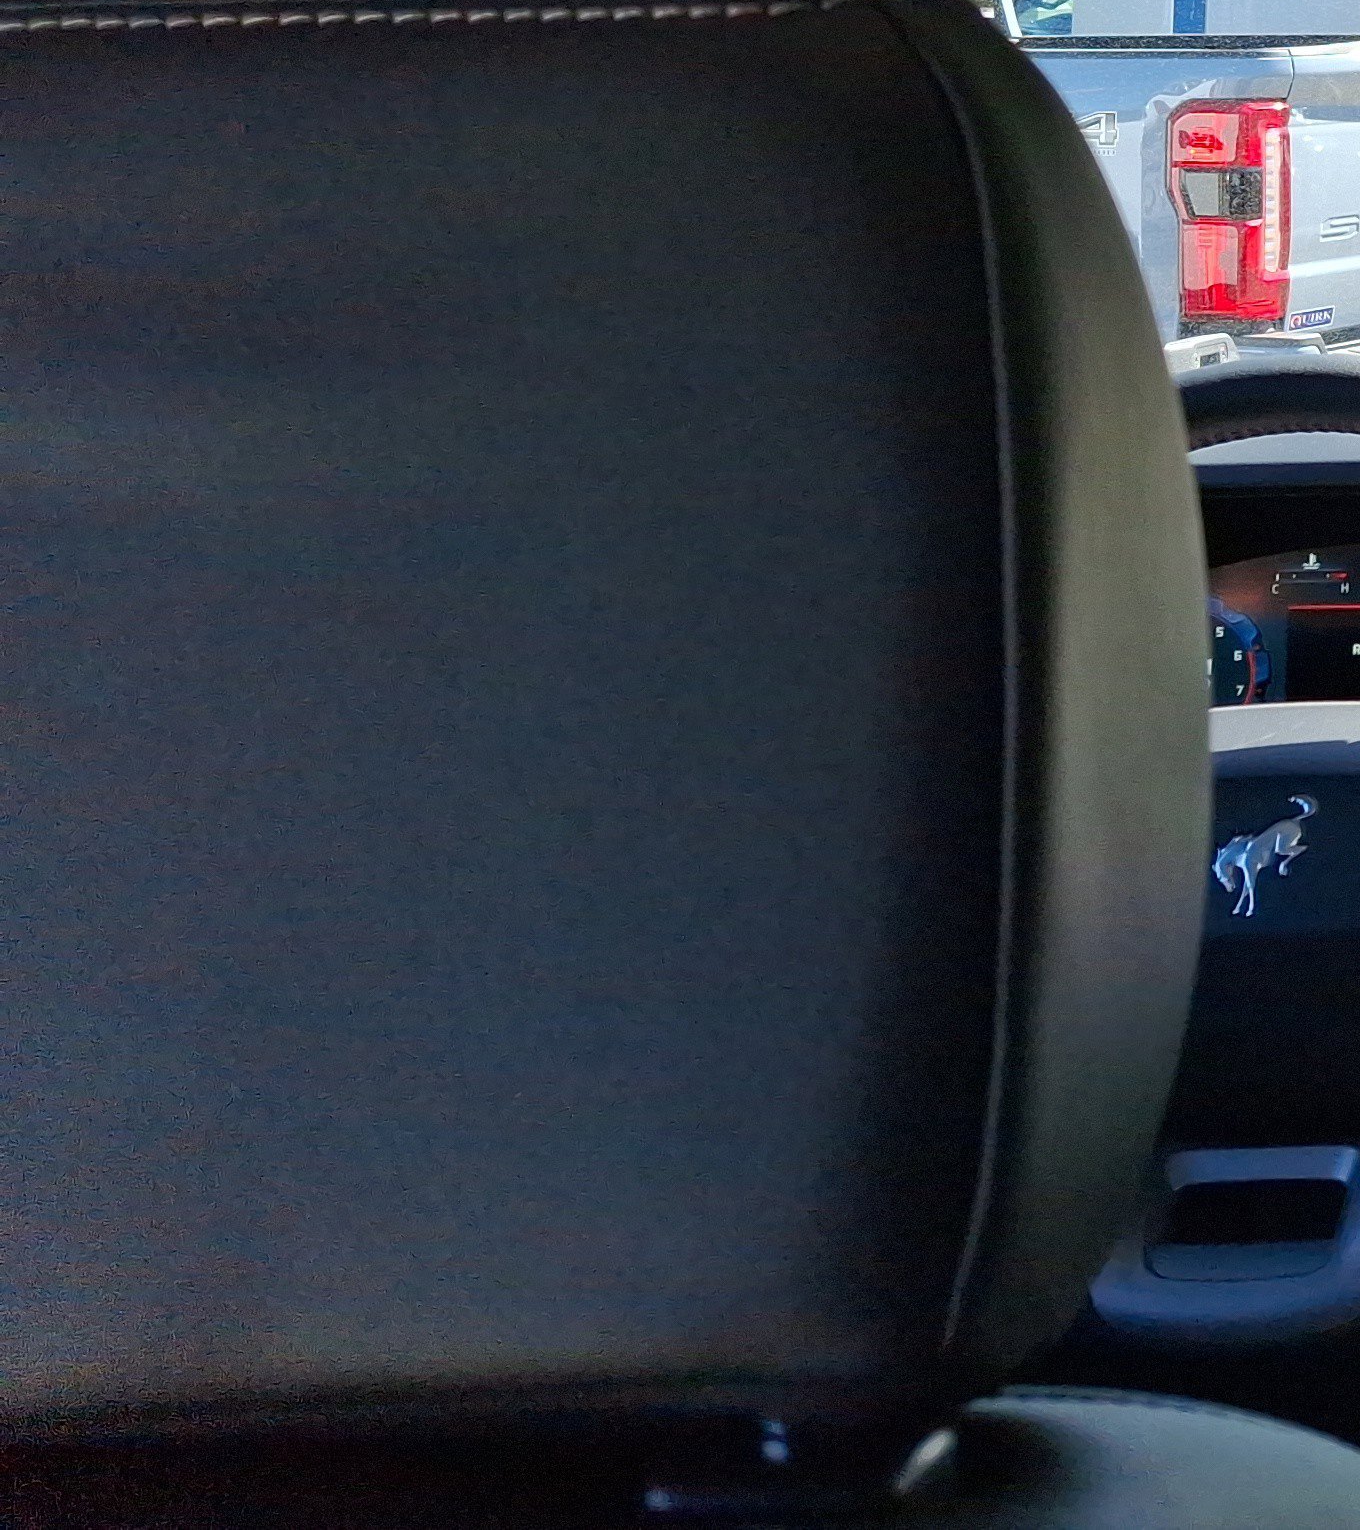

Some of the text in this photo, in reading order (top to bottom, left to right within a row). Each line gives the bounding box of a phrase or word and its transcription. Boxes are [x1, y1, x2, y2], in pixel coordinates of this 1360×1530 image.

[1272, 584, 1279, 594] C
[1340, 582, 1349, 593] H
[1215, 626, 1225, 638] 5
[1234, 650, 1242, 662] 6
[1236, 685, 1245, 696] 7
